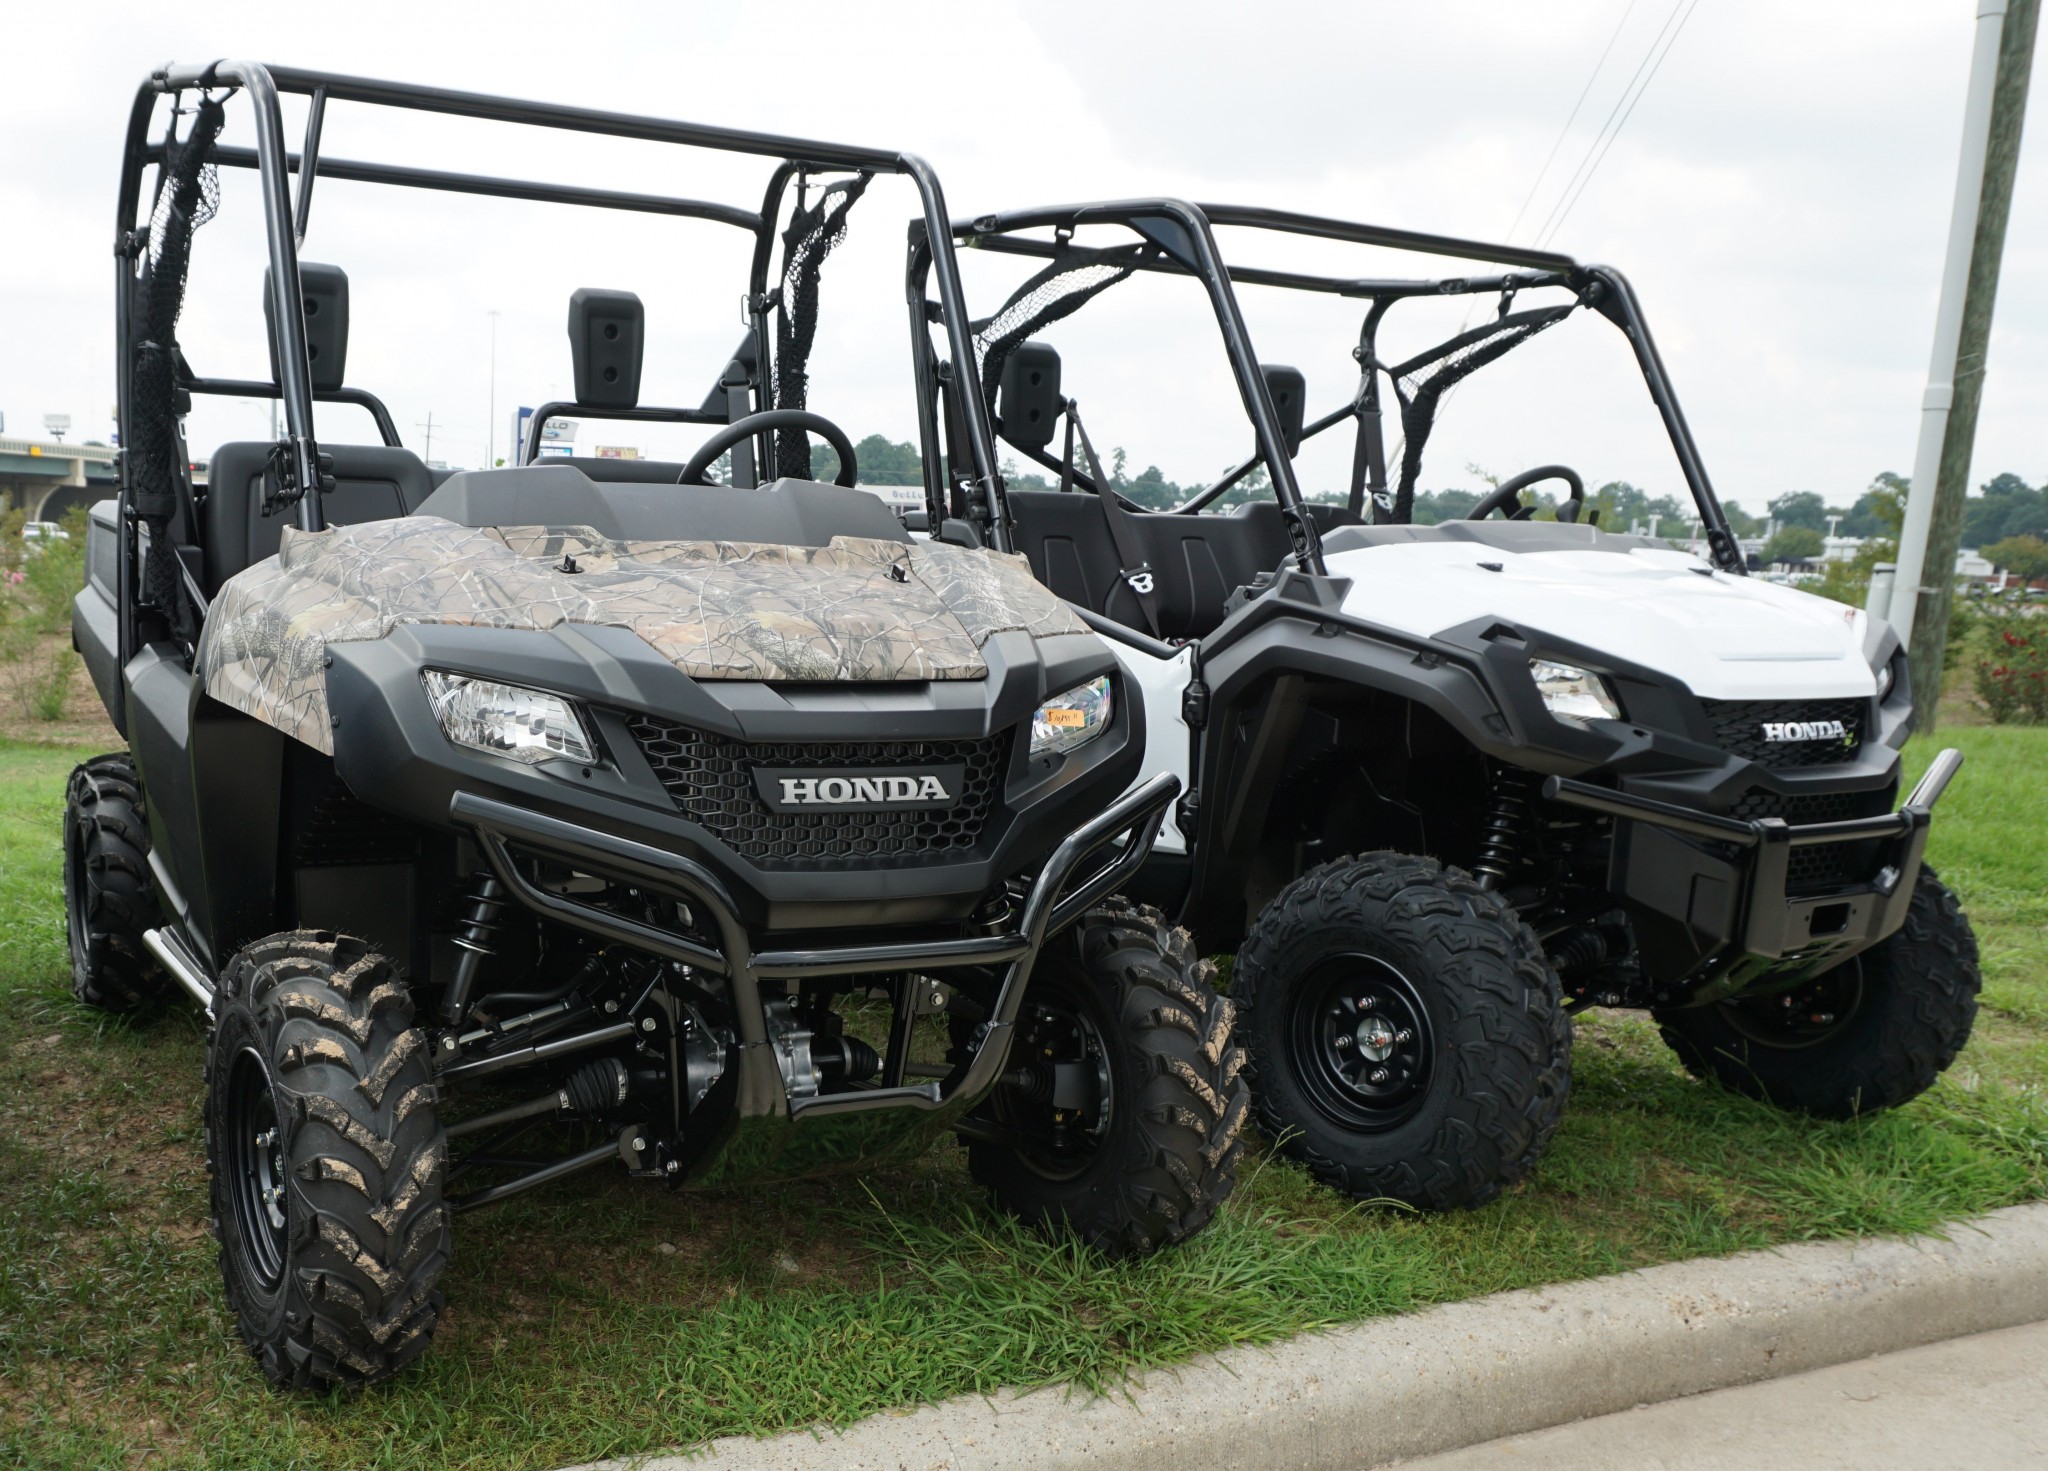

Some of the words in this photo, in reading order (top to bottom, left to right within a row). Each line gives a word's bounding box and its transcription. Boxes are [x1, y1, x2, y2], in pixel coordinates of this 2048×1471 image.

[543, 421, 568, 430] LLO
[1761, 719, 1848, 743] HONDA
[778, 775, 950, 805] HONDA
